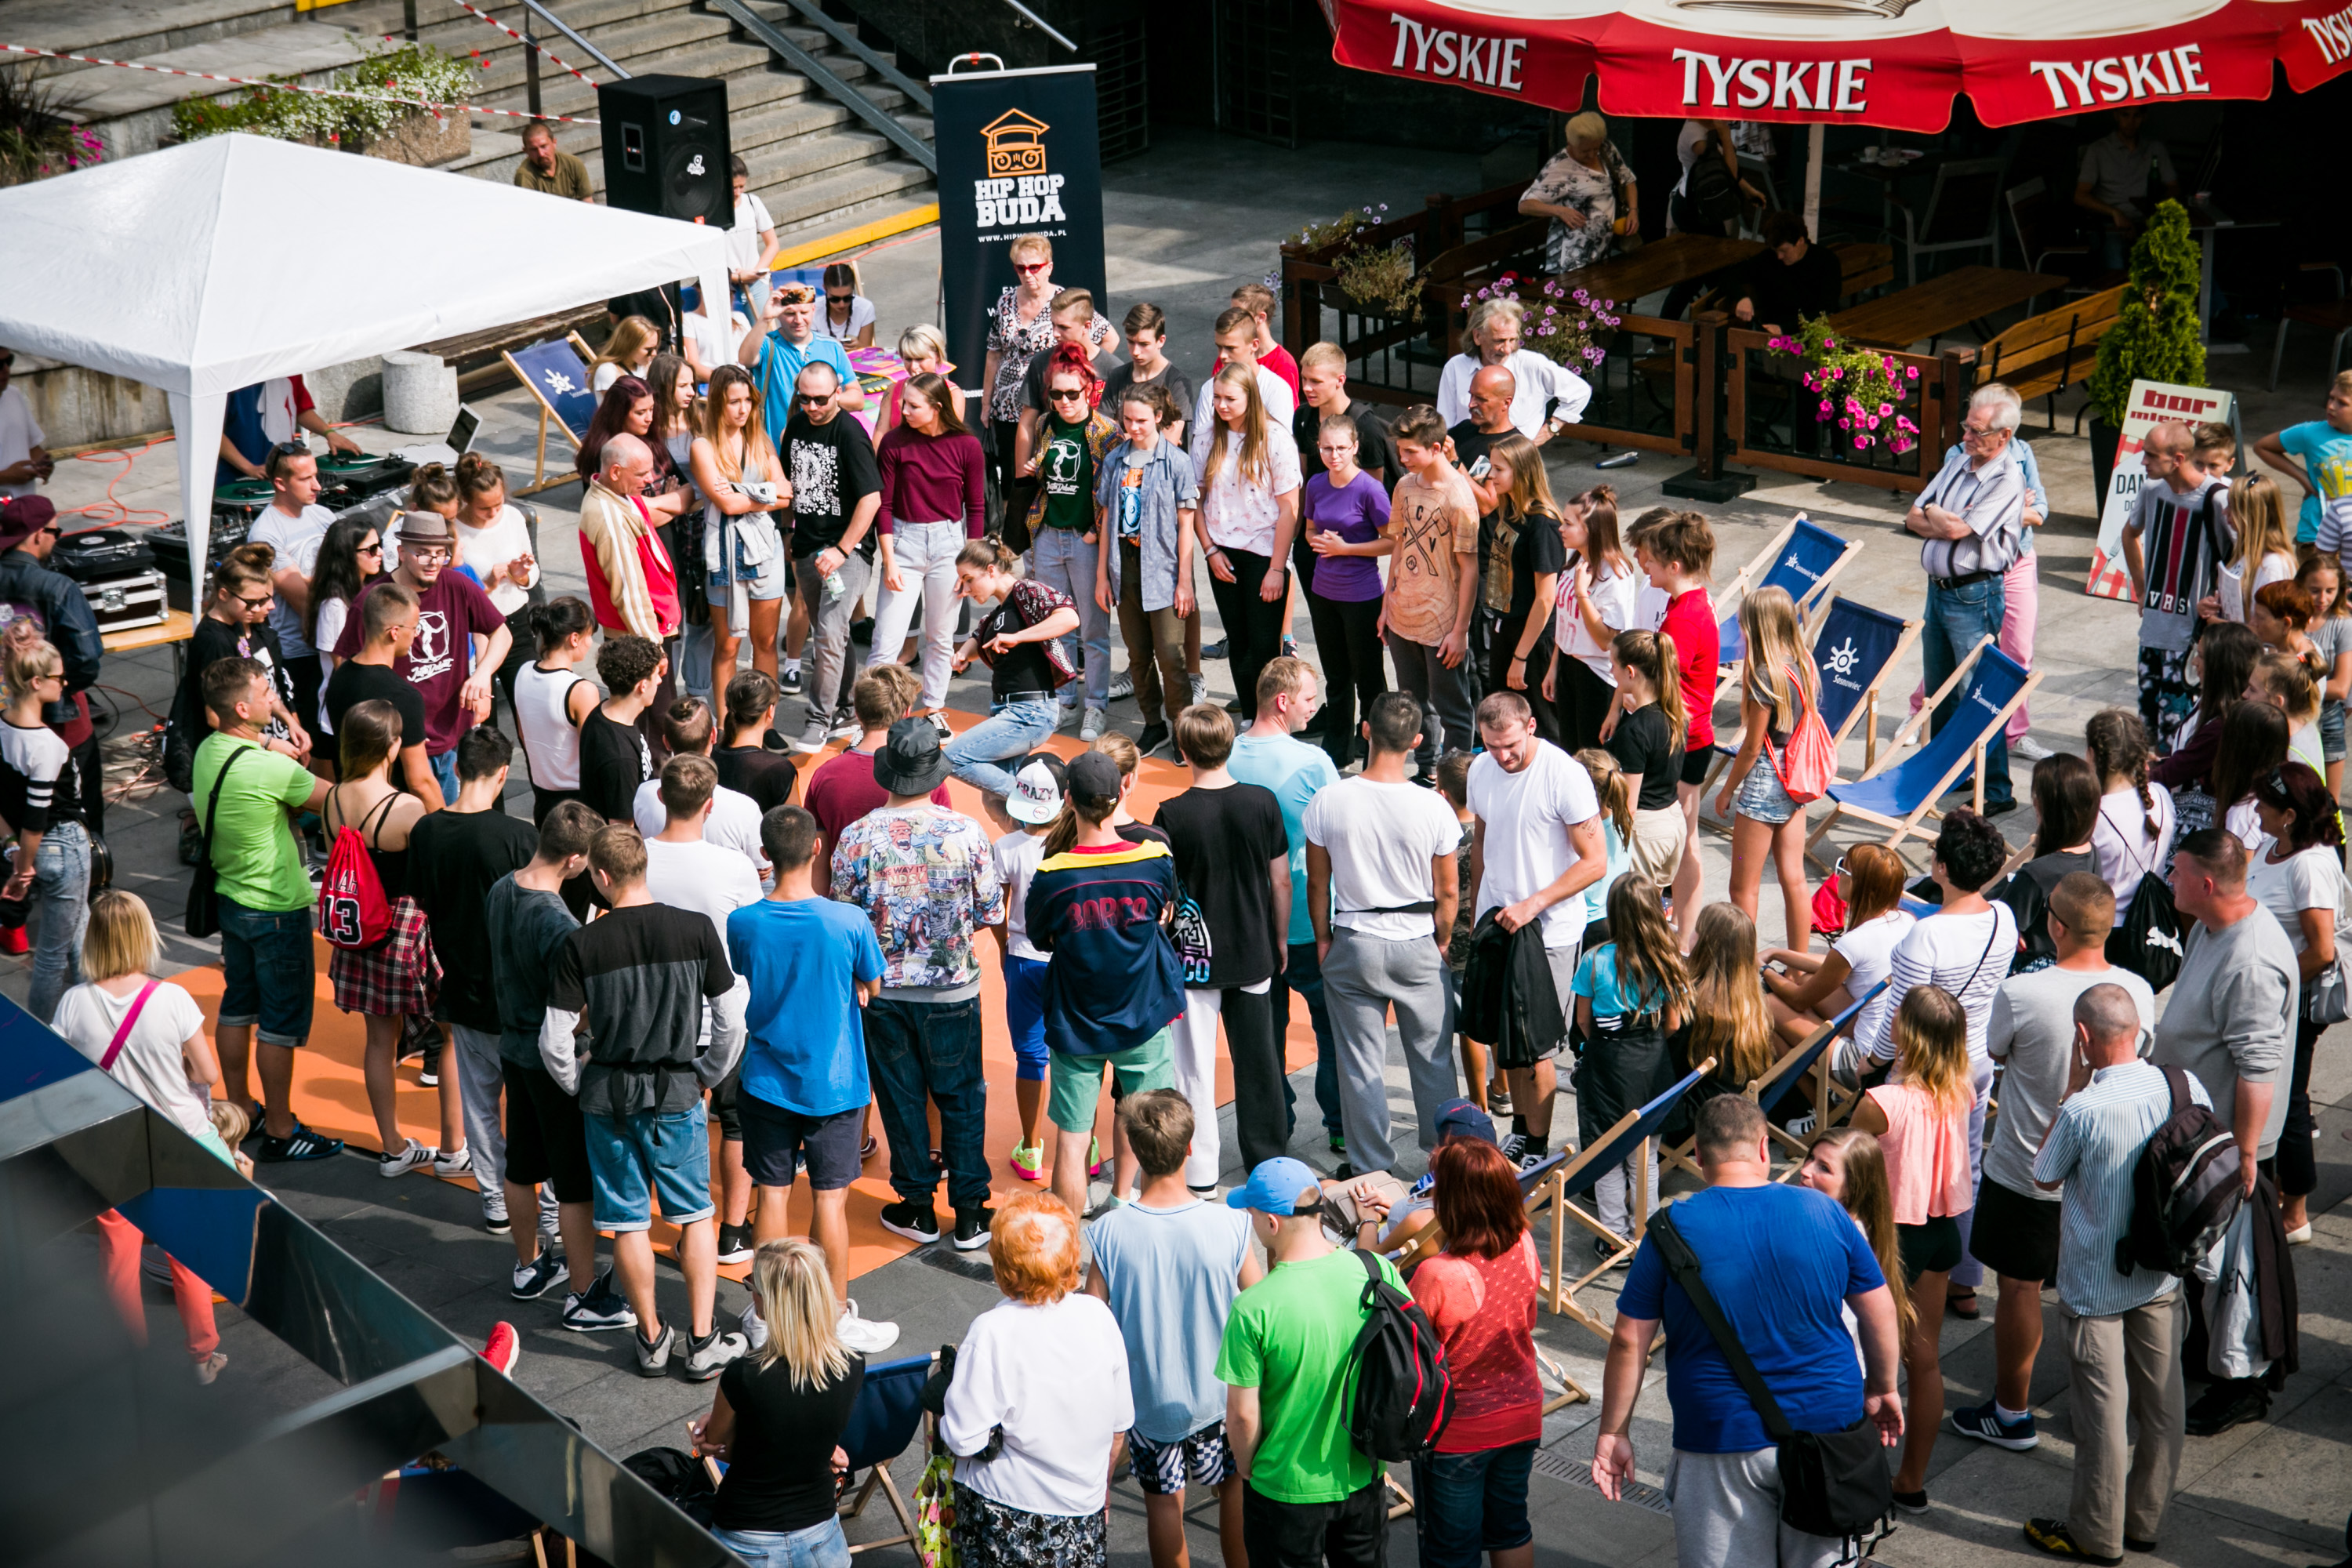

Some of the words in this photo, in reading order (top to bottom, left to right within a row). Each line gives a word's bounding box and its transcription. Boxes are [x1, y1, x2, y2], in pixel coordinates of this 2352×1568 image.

[1391, 13, 1528, 93] TYSKIE
[1672, 48, 1874, 113] TYSKIE
[2031, 43, 2211, 111] TYSKIE
[975, 178, 1014, 201] HIP
[1018, 174, 1065, 198] HOP
[976, 194, 1066, 228] BUDA
[2143, 389, 2217, 415] bar
[1832, 674, 1862, 691] Sosnowiec
[1017, 781, 1054, 800] CRAZY
[888, 872, 925, 886] NDS!
[321, 895, 362, 945] 13
